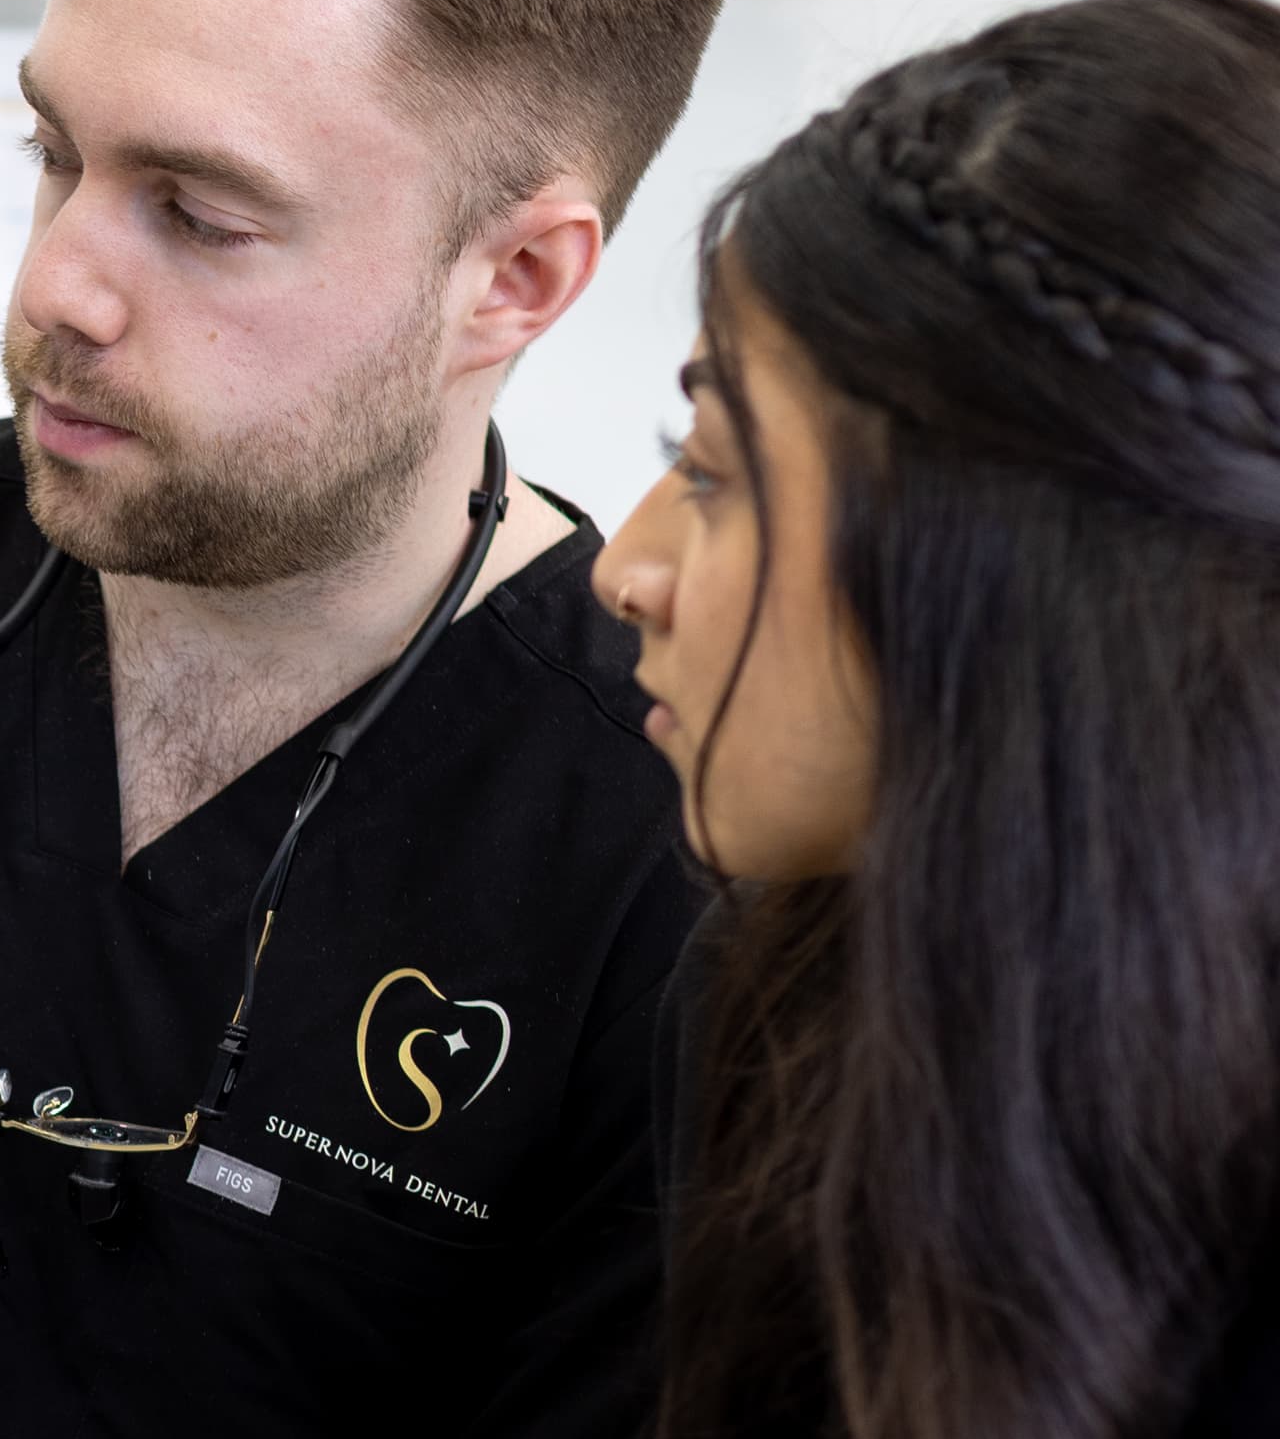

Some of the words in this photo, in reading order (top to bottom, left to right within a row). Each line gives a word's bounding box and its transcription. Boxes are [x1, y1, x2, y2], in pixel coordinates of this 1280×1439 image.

[215, 1165, 254, 1195] FIGS
[265, 1115, 395, 1184] SUPERNOVA
[405, 1174, 491, 1220] DENTAL
